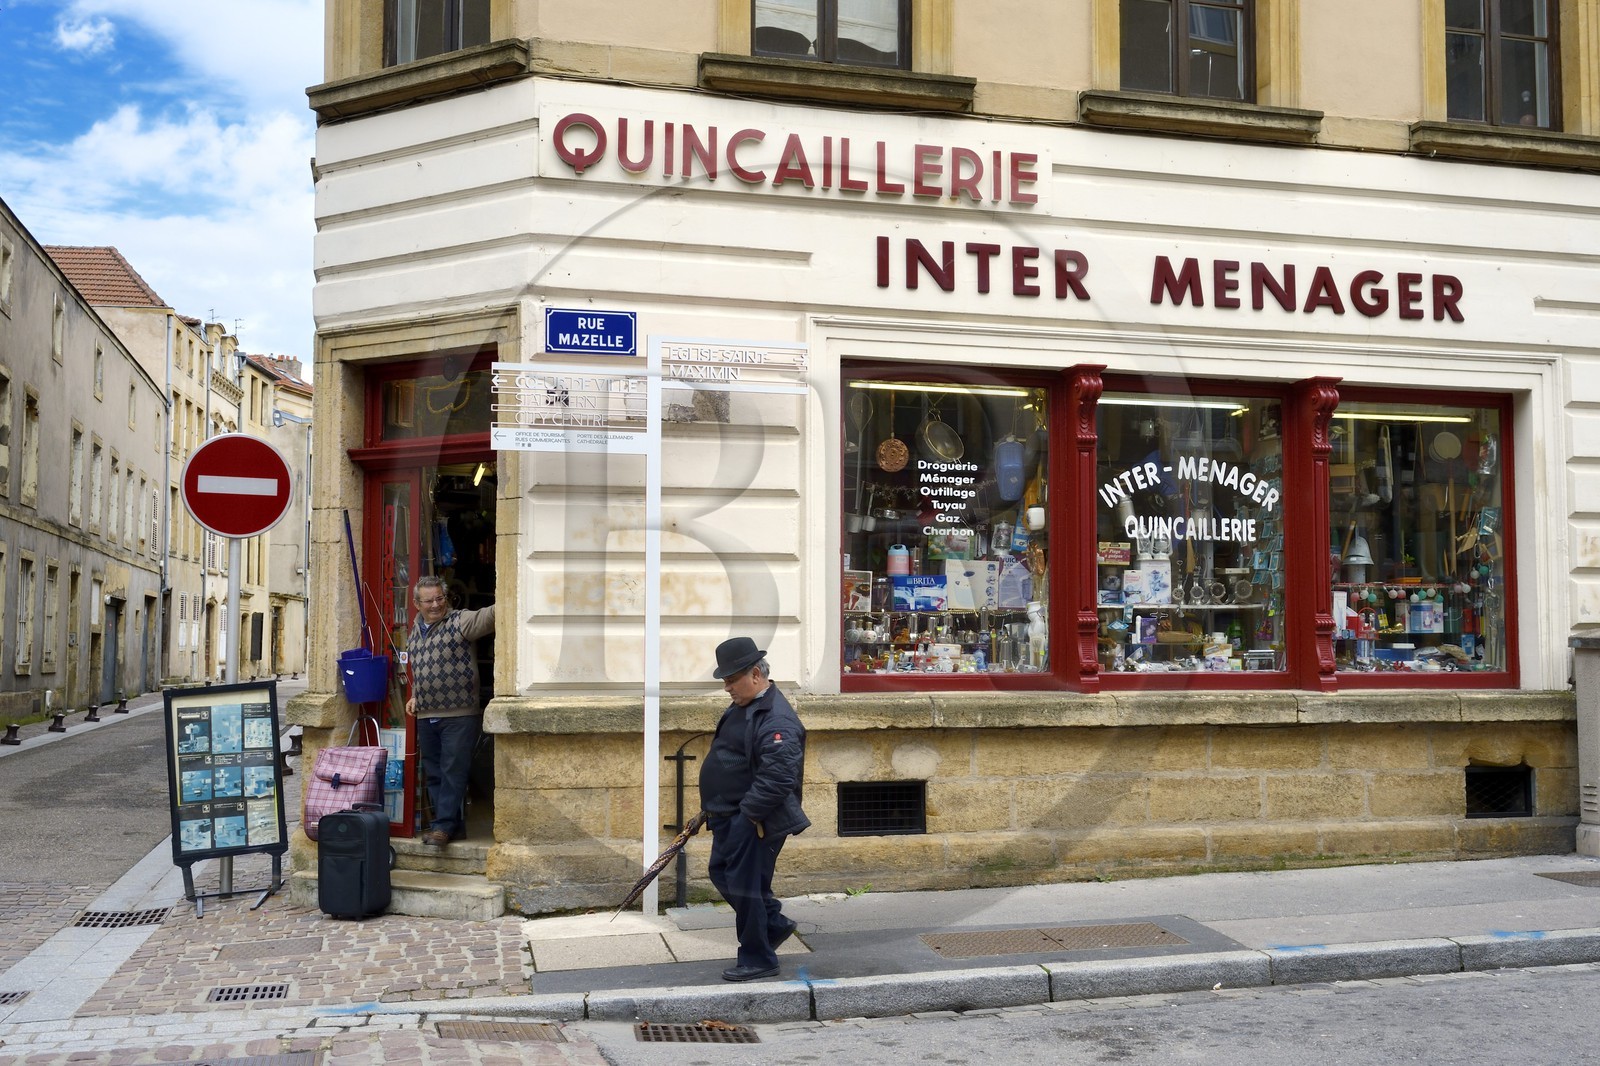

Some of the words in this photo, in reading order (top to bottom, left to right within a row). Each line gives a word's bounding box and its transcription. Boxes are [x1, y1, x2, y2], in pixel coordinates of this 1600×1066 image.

[552, 112, 1039, 205] QUINCAILLERIE
[876, 235, 1091, 301] INTER
[1149, 254, 1465, 322] MENAGER
[577, 317, 605, 330] RUE
[558, 332, 624, 348] MAZELLE
[669, 364, 740, 380] MAXIMIN
[593, 378, 638, 392] VILLE
[515, 392, 597, 409] STADTKERN
[515, 411, 549, 425] CITY
[552, 412, 609, 428] CENTRE
[917, 460, 978, 472] Droguerie
[919, 473, 976, 486] Ménager
[1098, 461, 1161, 509] INTER
[1177, 455, 1280, 512] MENAGER
[920, 486, 976, 499] Outillage
[930, 500, 967, 512] Tuyau
[935, 513, 961, 523] Gaz
[922, 526, 975, 537] Charbon
[1124, 515, 1257, 541] QUINCAILLERIE
[913, 577, 936, 585] BRITA
